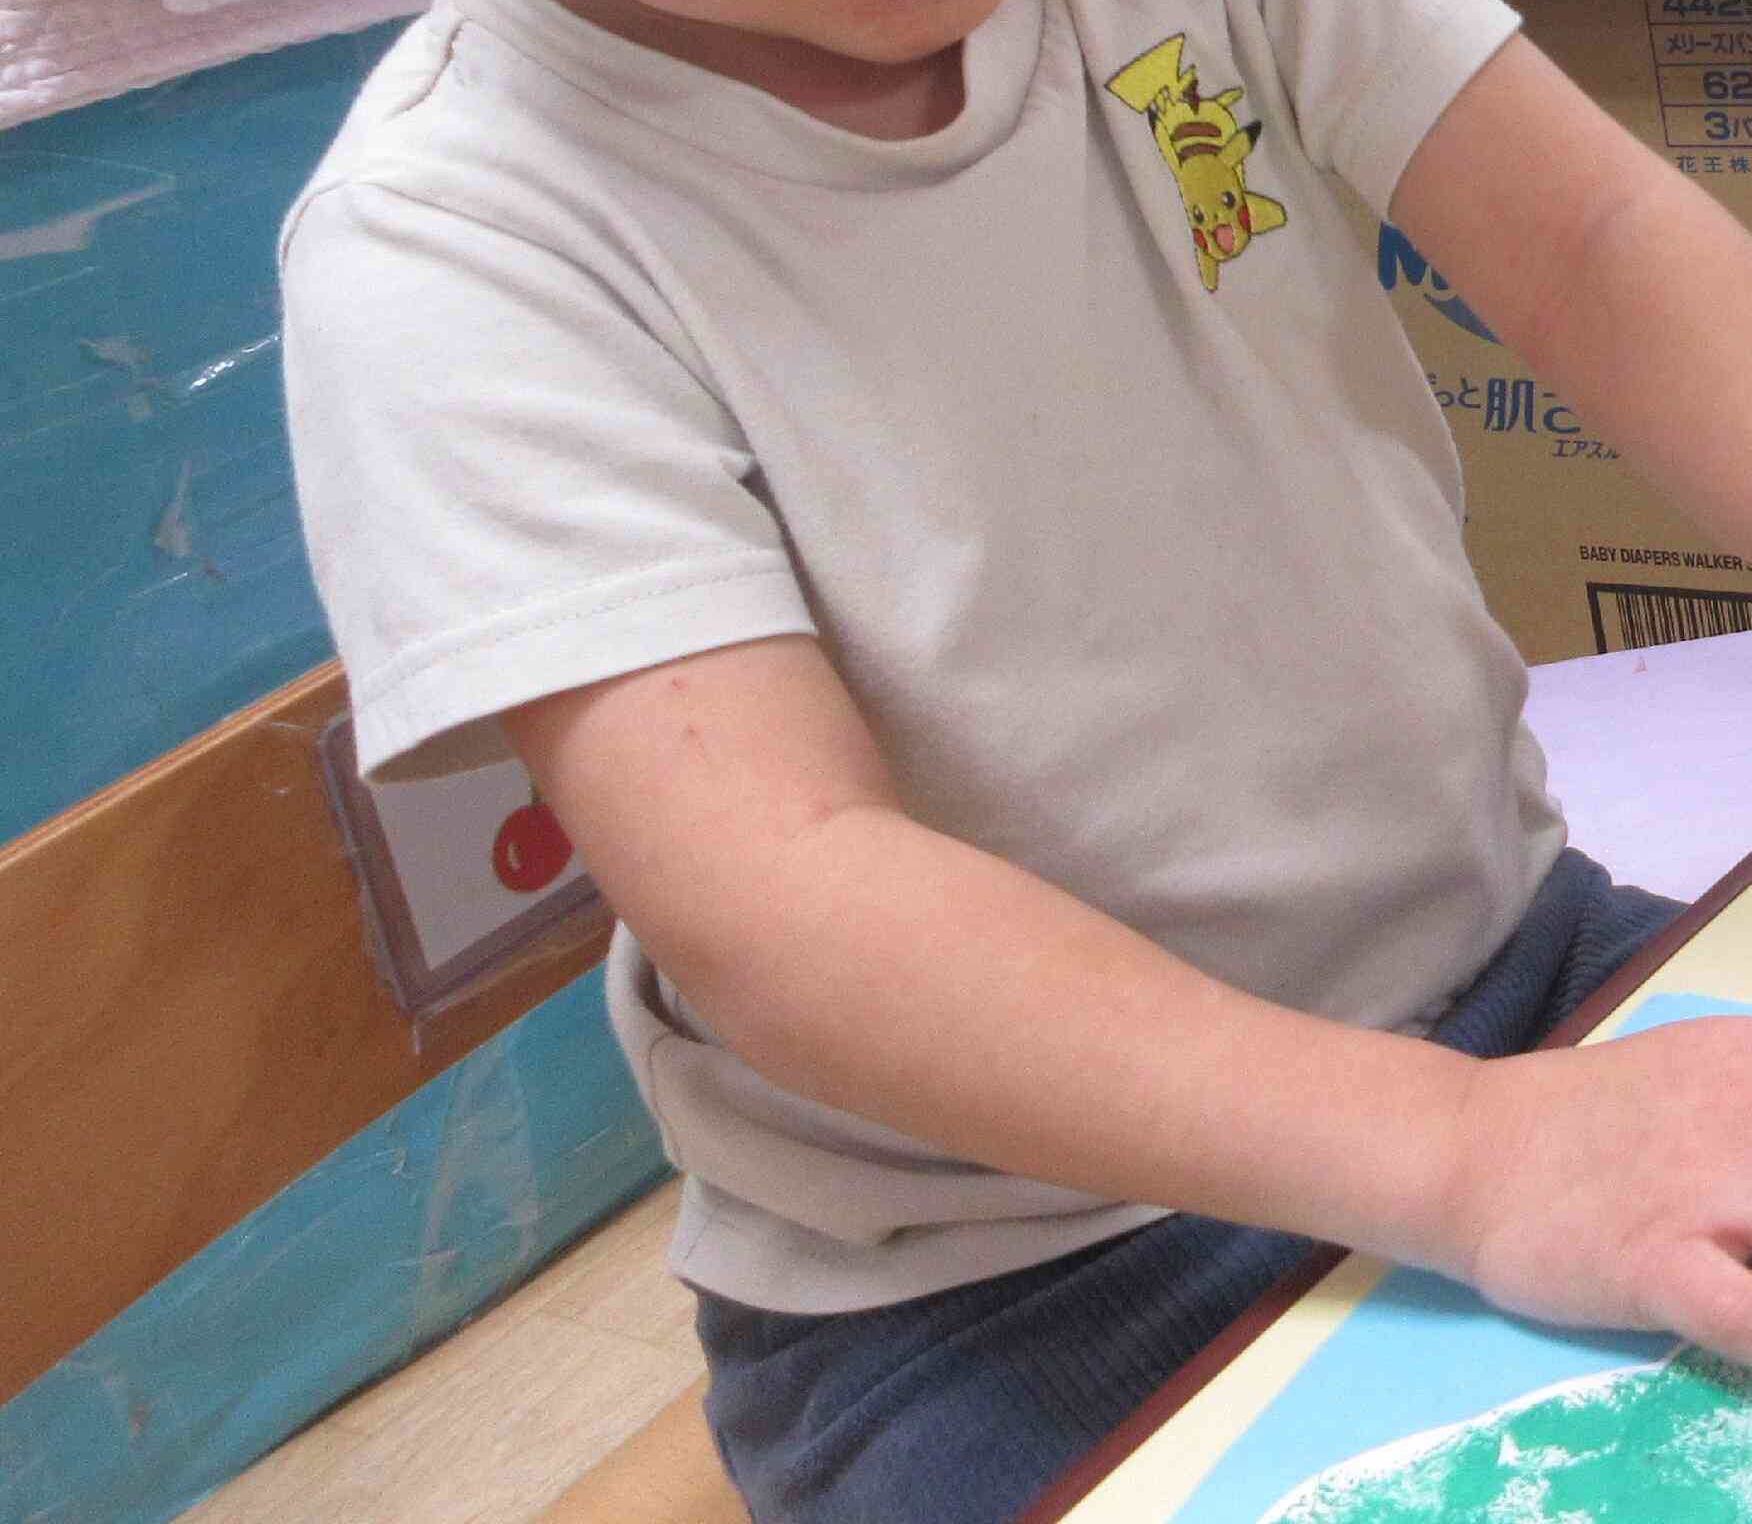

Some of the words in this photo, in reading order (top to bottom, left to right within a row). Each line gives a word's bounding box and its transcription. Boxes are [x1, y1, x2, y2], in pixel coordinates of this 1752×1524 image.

[1579, 545, 1616, 563] BABY
[1620, 548, 1681, 567] DIAPERS
[1682, 552, 1743, 571] WALKER
